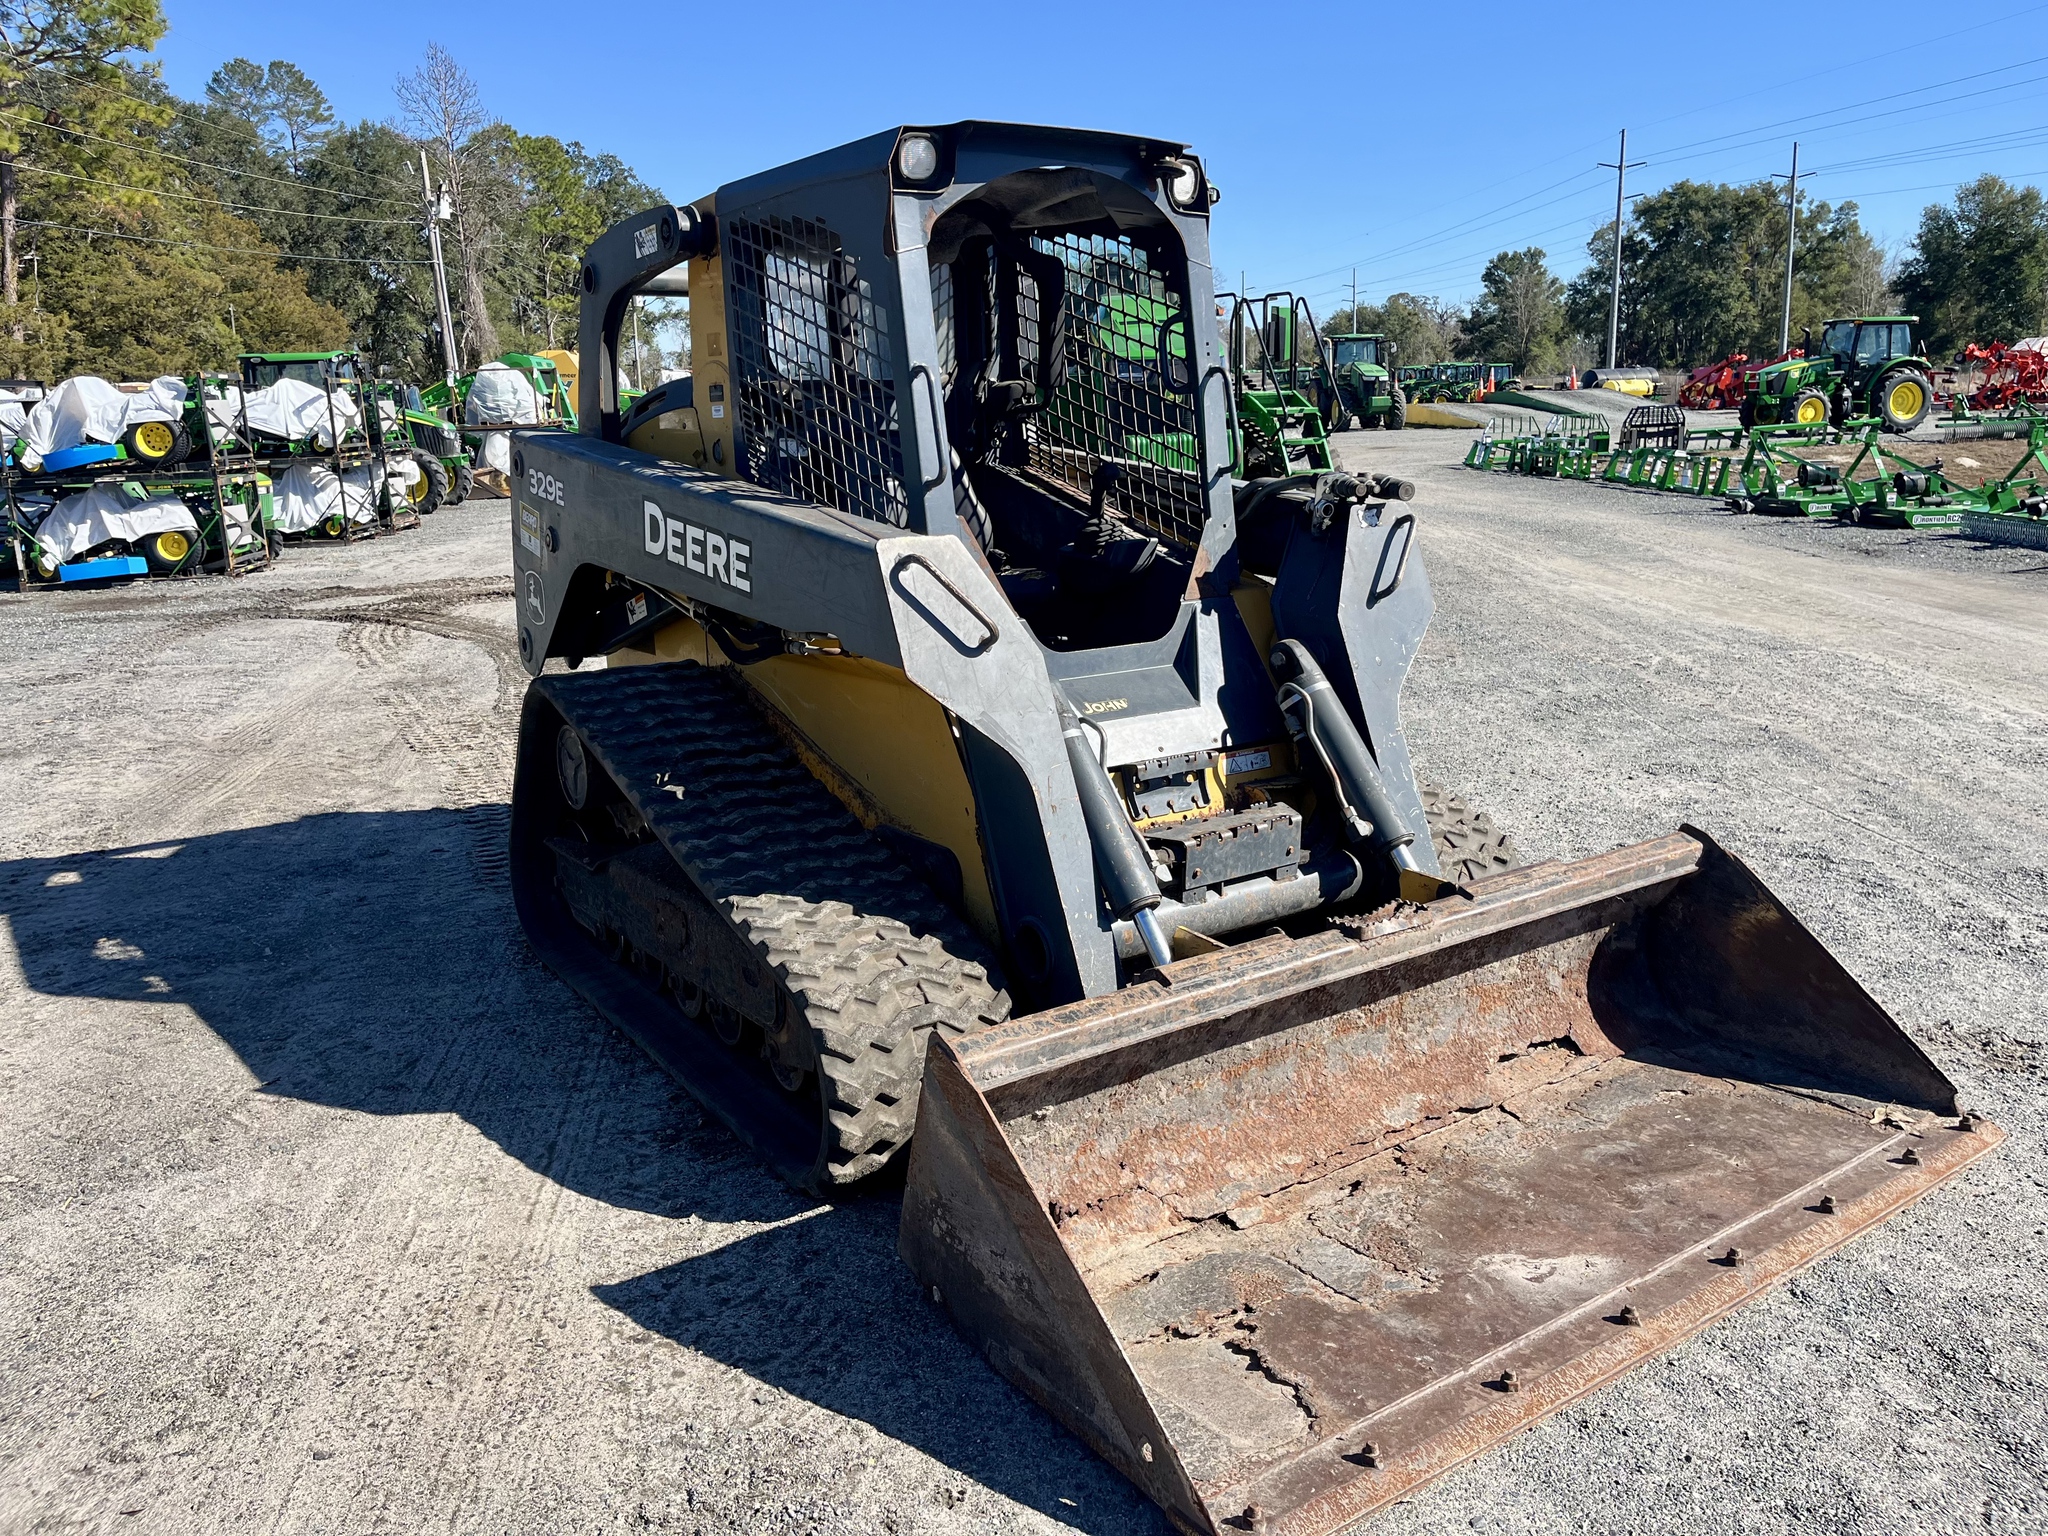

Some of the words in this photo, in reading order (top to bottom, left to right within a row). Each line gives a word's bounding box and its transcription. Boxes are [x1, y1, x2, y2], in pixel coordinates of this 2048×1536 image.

[528, 468, 565, 506] 329E
[1913, 515, 1945, 524] FRONTIER
[644, 500, 751, 593] DEERE
[1082, 699, 1128, 714] JOHN
